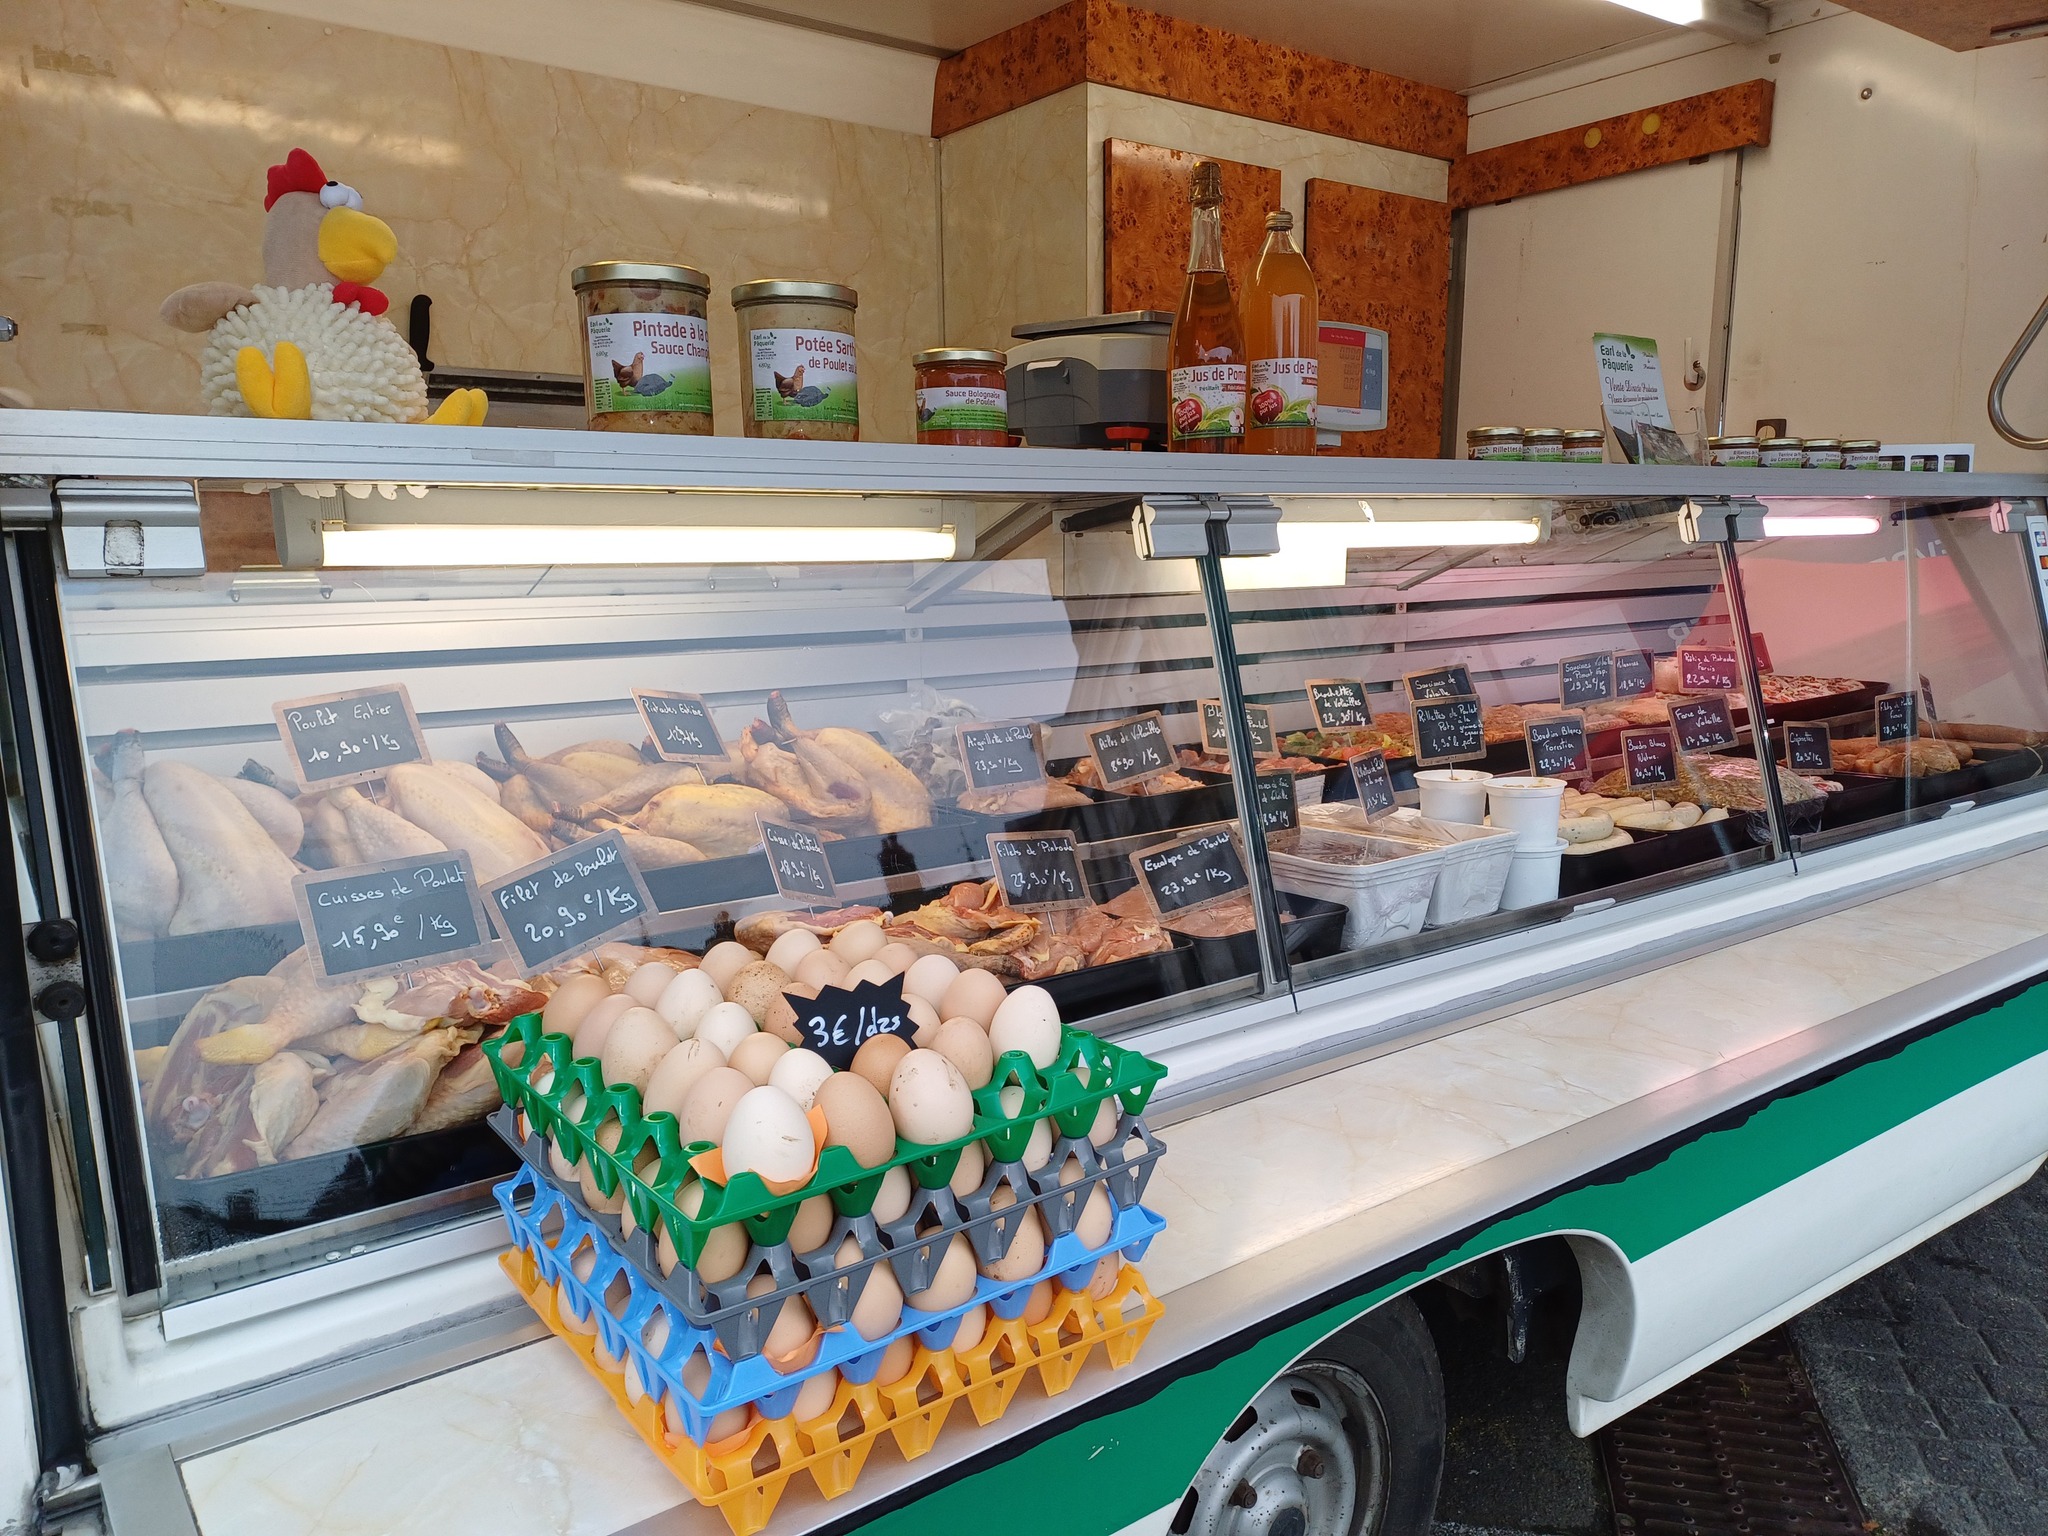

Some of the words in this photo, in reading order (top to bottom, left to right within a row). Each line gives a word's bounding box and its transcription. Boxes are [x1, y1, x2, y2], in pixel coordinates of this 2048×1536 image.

[633, 320, 687, 338] Pintade
[690, 322, 696, 340] à
[697, 325, 705, 341] la
[651, 341, 684, 355] Sauce
[795, 336, 833, 353] Potée
[1600, 345, 1615, 356] Earl
[809, 357, 821, 368] de
[823, 358, 848, 372] Poulet
[1272, 361, 1291, 374] Jus
[1293, 360, 1305, 374] de
[1602, 358, 1634, 372] Pâquerie
[1191, 370, 1209, 383] Jus
[1211, 367, 1225, 381] de
[945, 390, 967, 398] Sauce
[968, 390, 1000, 400] Bolognaise
[976, 398, 996, 406] Poulet
[288, 707, 339, 732] Poulet
[353, 702, 392, 720] Entier
[996, 841, 1021, 858] Filets
[1037, 838, 1075, 853] Pintade
[1144, 854, 1184, 871] Escalope
[1198, 832, 1231, 850] Poulet
[318, 886, 385, 907] Cuisses
[413, 864, 467, 889] Poulet
[500, 880, 540, 910] Filet
[552, 869, 575, 889] de
[574, 846, 618, 877] Poulet
